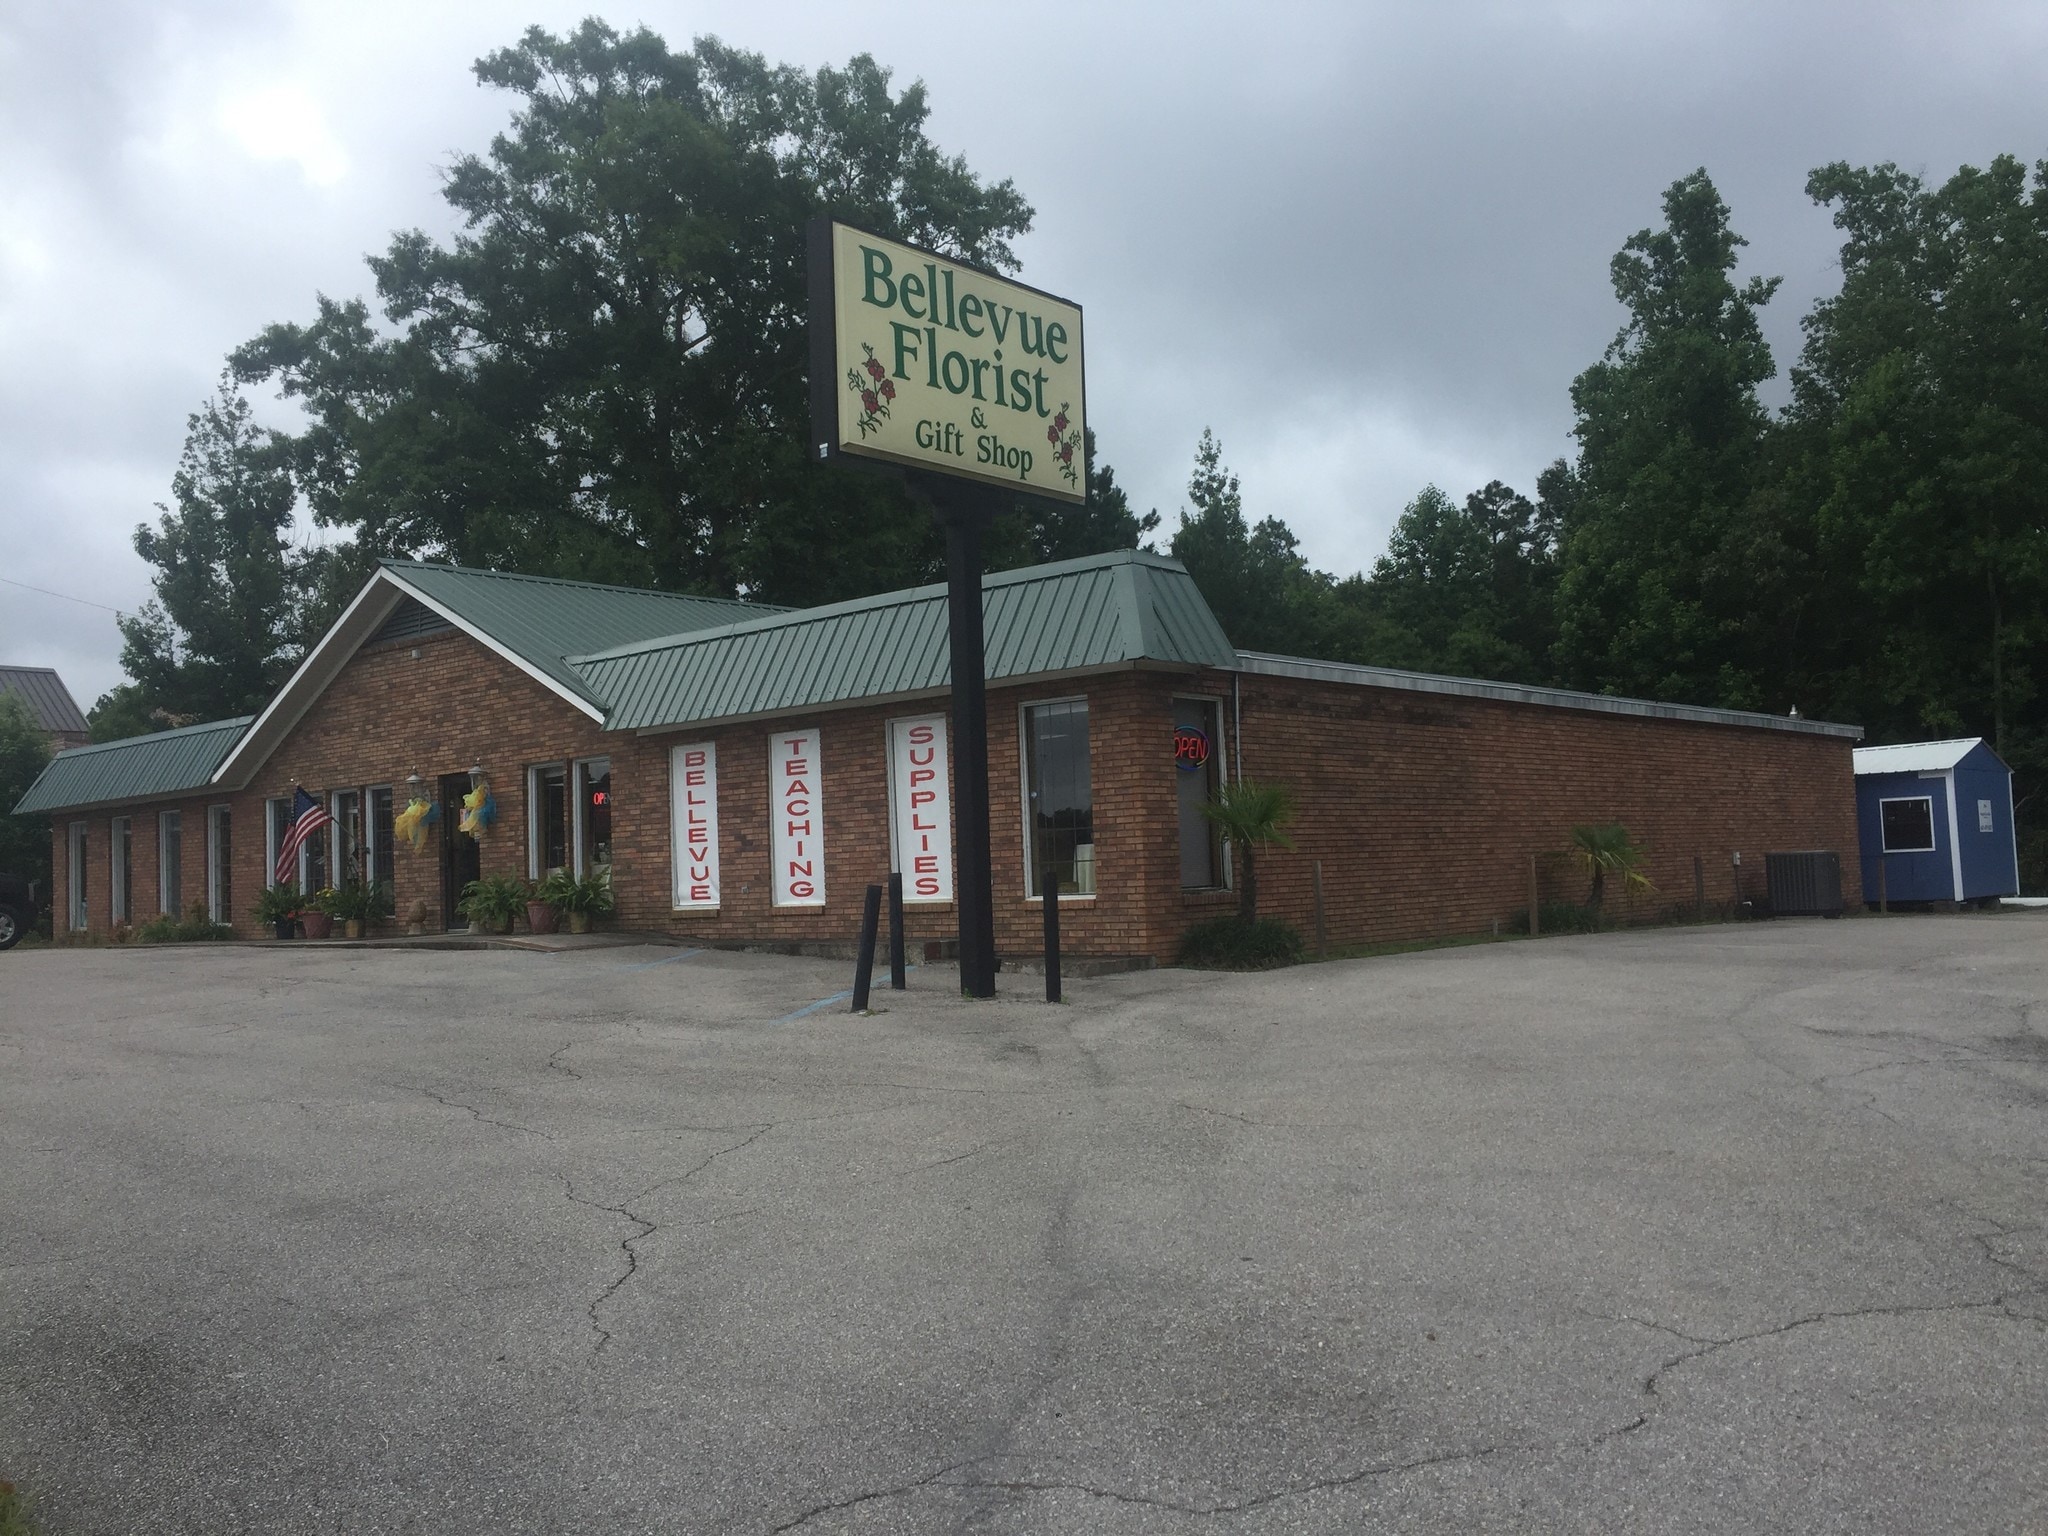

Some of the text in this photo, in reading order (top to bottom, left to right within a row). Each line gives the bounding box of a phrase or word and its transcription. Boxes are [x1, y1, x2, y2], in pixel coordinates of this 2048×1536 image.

[859, 245, 1069, 364] Bellevue
[889, 321, 1051, 418] Florist
[970, 407, 987, 430] &
[915, 419, 1033, 481] Gift Shop
[1174, 737, 1206, 759] OPEN
[685, 751, 712, 901] BELLEVUE
[784, 738, 814, 898] TEACHING
[909, 726, 940, 896] SUPPLIES
